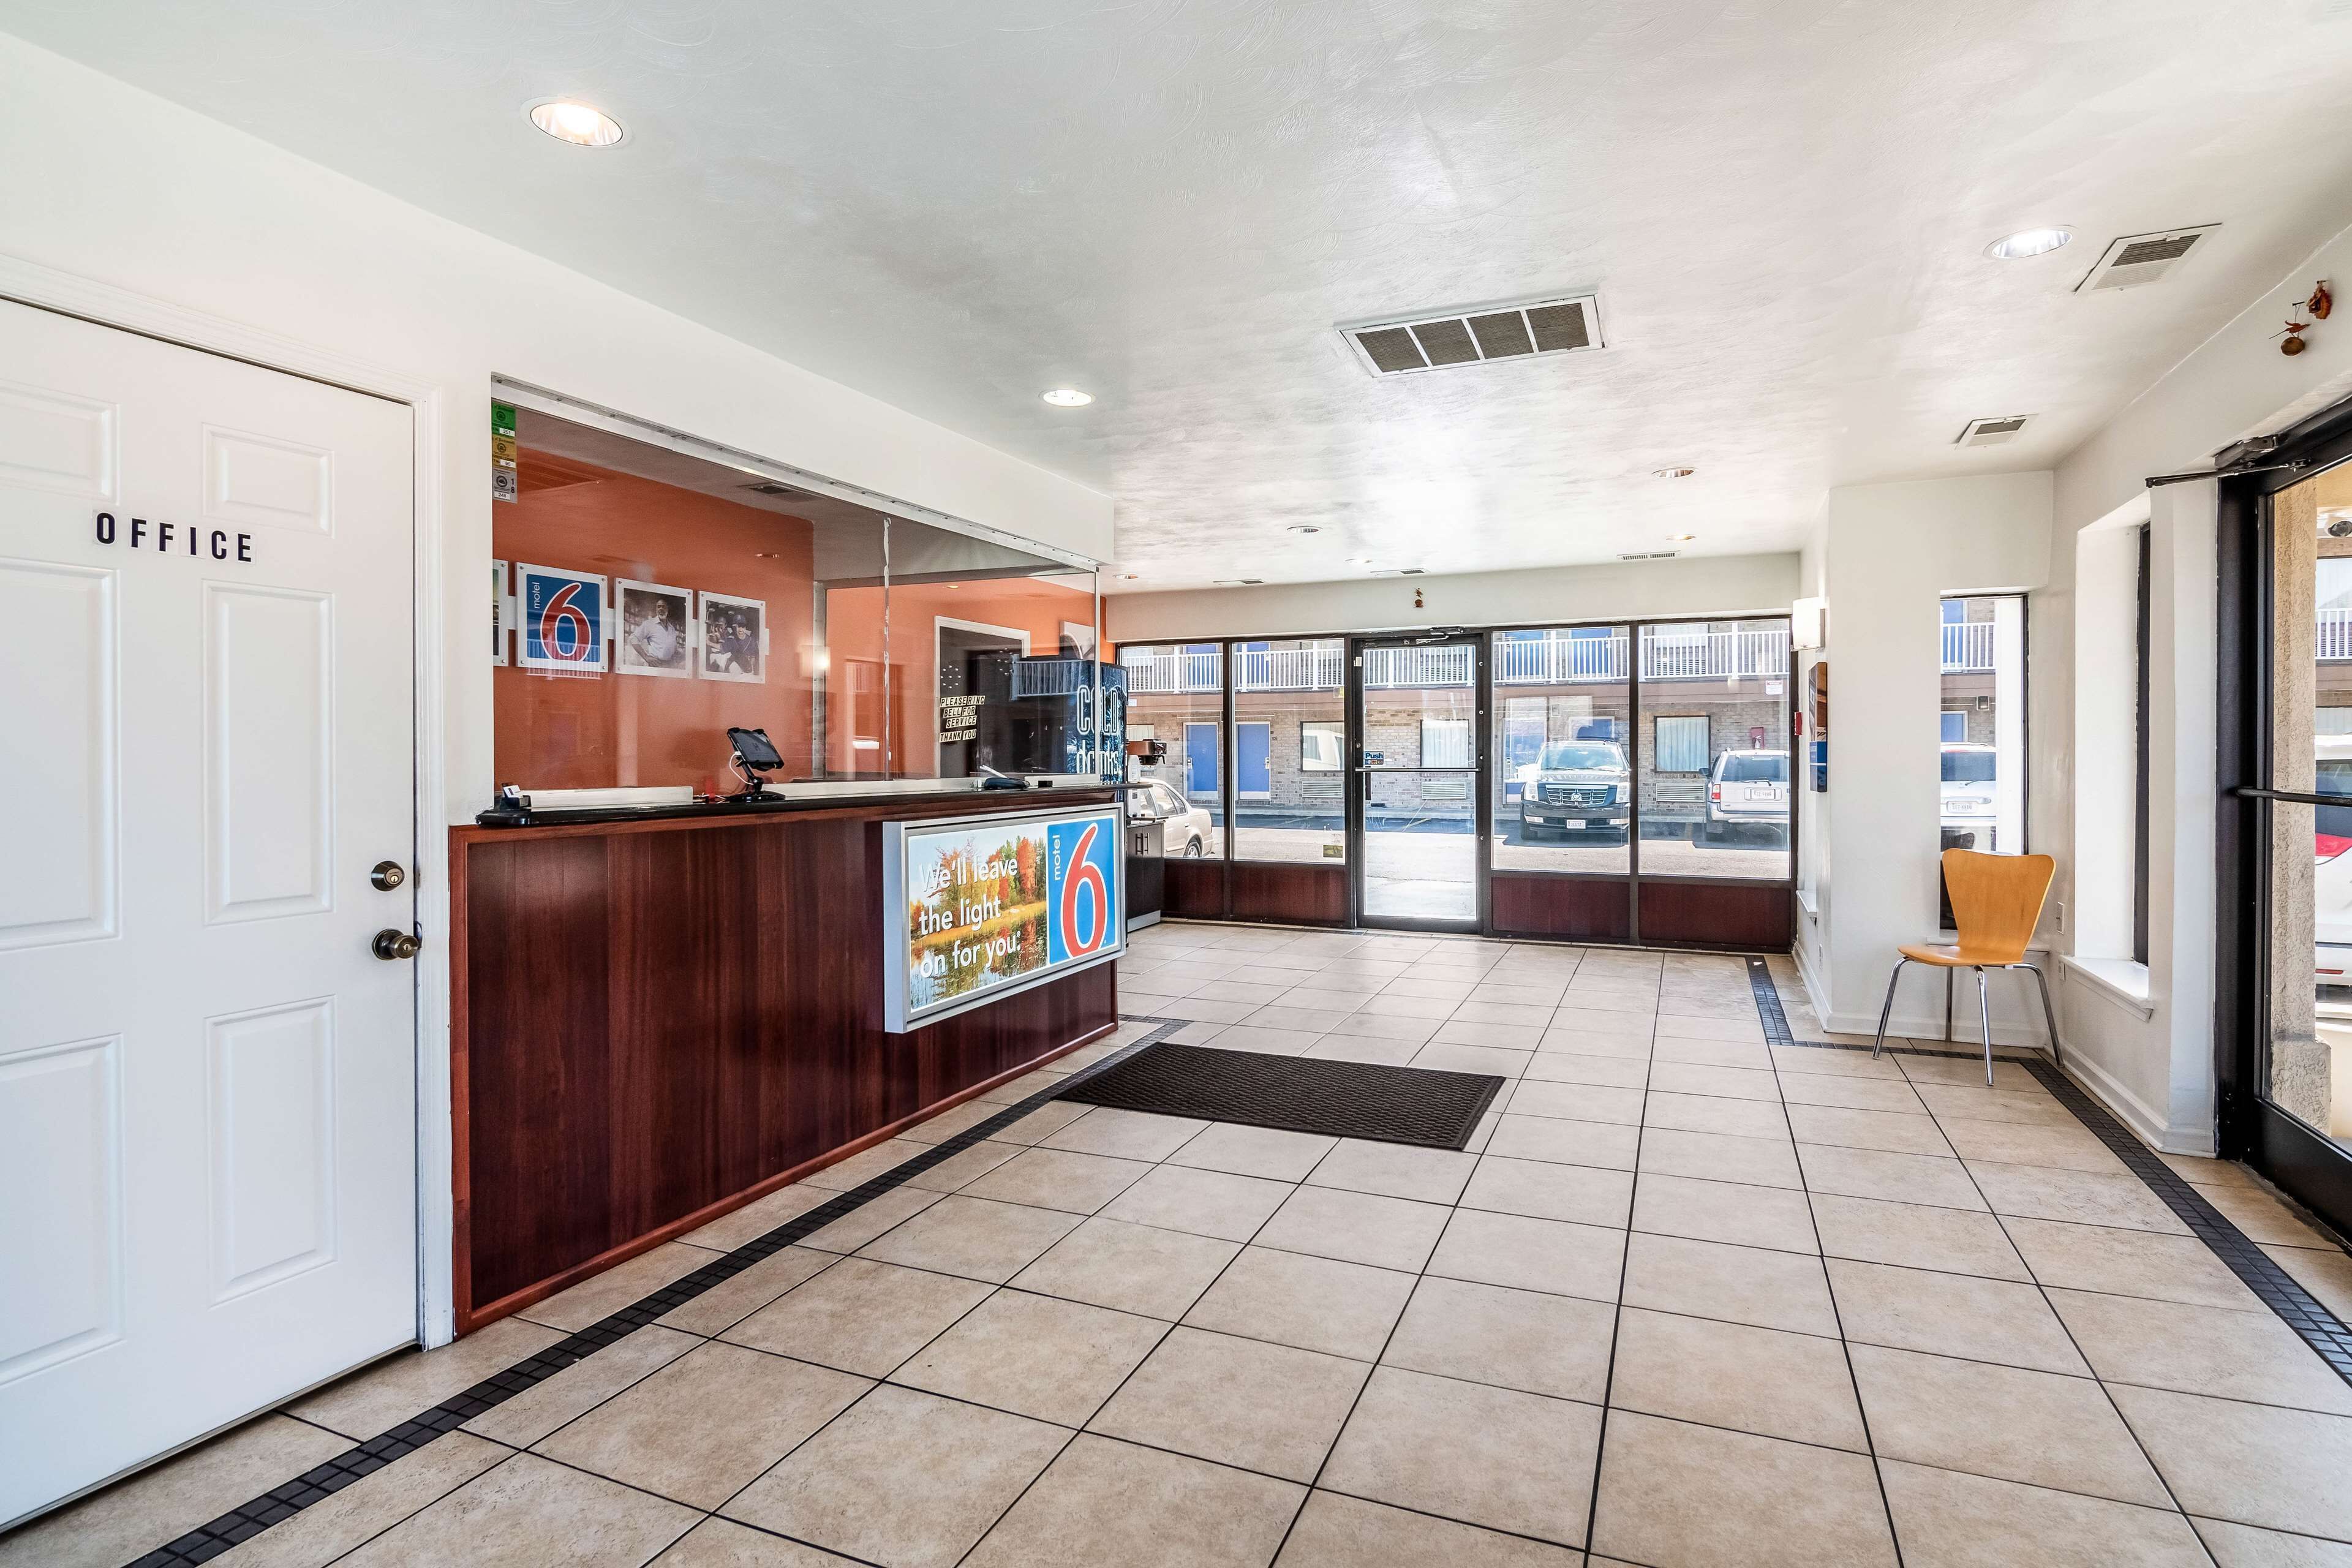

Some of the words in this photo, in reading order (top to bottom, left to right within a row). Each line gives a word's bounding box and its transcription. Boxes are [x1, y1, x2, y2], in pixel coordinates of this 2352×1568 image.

[96, 512, 252, 563] OFFICE
[532, 582, 540, 609] motel
[540, 582, 592, 661] 6
[941, 696, 967, 706] PLEASE
[944, 708, 961, 717] BELL
[963, 706, 975, 715] FOR
[940, 731, 961, 741] THANK
[964, 729, 976, 739] YOU
[946, 716, 976, 728] SERVICE
[1076, 739, 1119, 775] drnks
[919, 857, 967, 892] We'll
[973, 856, 1019, 883] leave
[1052, 834, 1061, 881] motel
[1060, 823, 1108, 959] 6
[919, 903, 953, 935] the
[960, 894, 1001, 931] light
[920, 952, 946, 978] on
[952, 940, 980, 970] for
